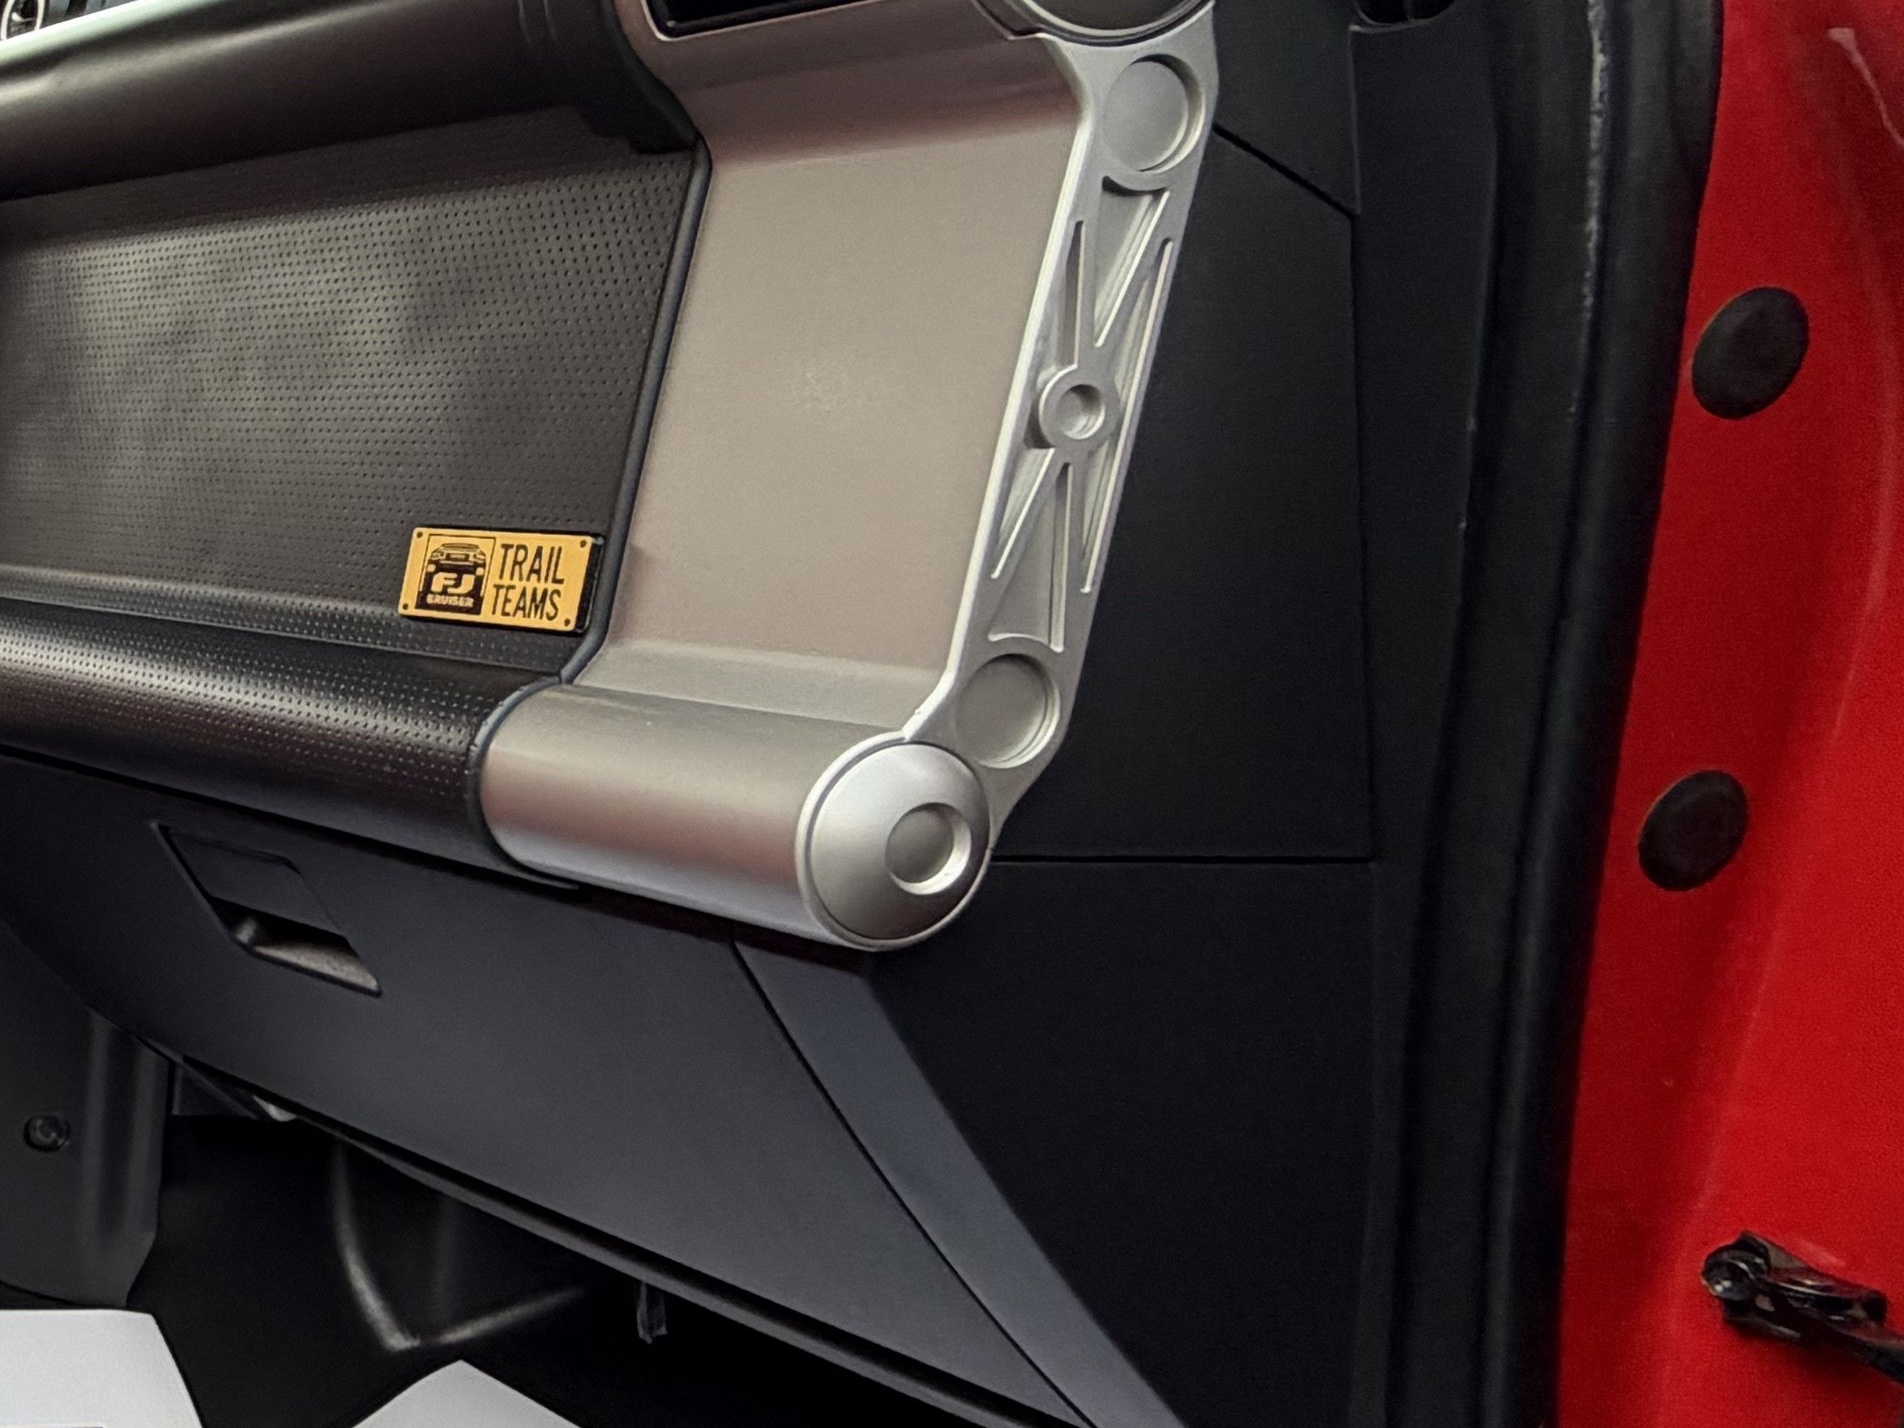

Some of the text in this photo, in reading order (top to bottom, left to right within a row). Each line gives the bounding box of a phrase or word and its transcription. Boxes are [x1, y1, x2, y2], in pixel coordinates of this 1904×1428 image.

[498, 543, 565, 585] TRAIL
[430, 572, 476, 595] FJ
[426, 593, 474, 608] CRUISER
[491, 583, 562, 622] TEAMS
